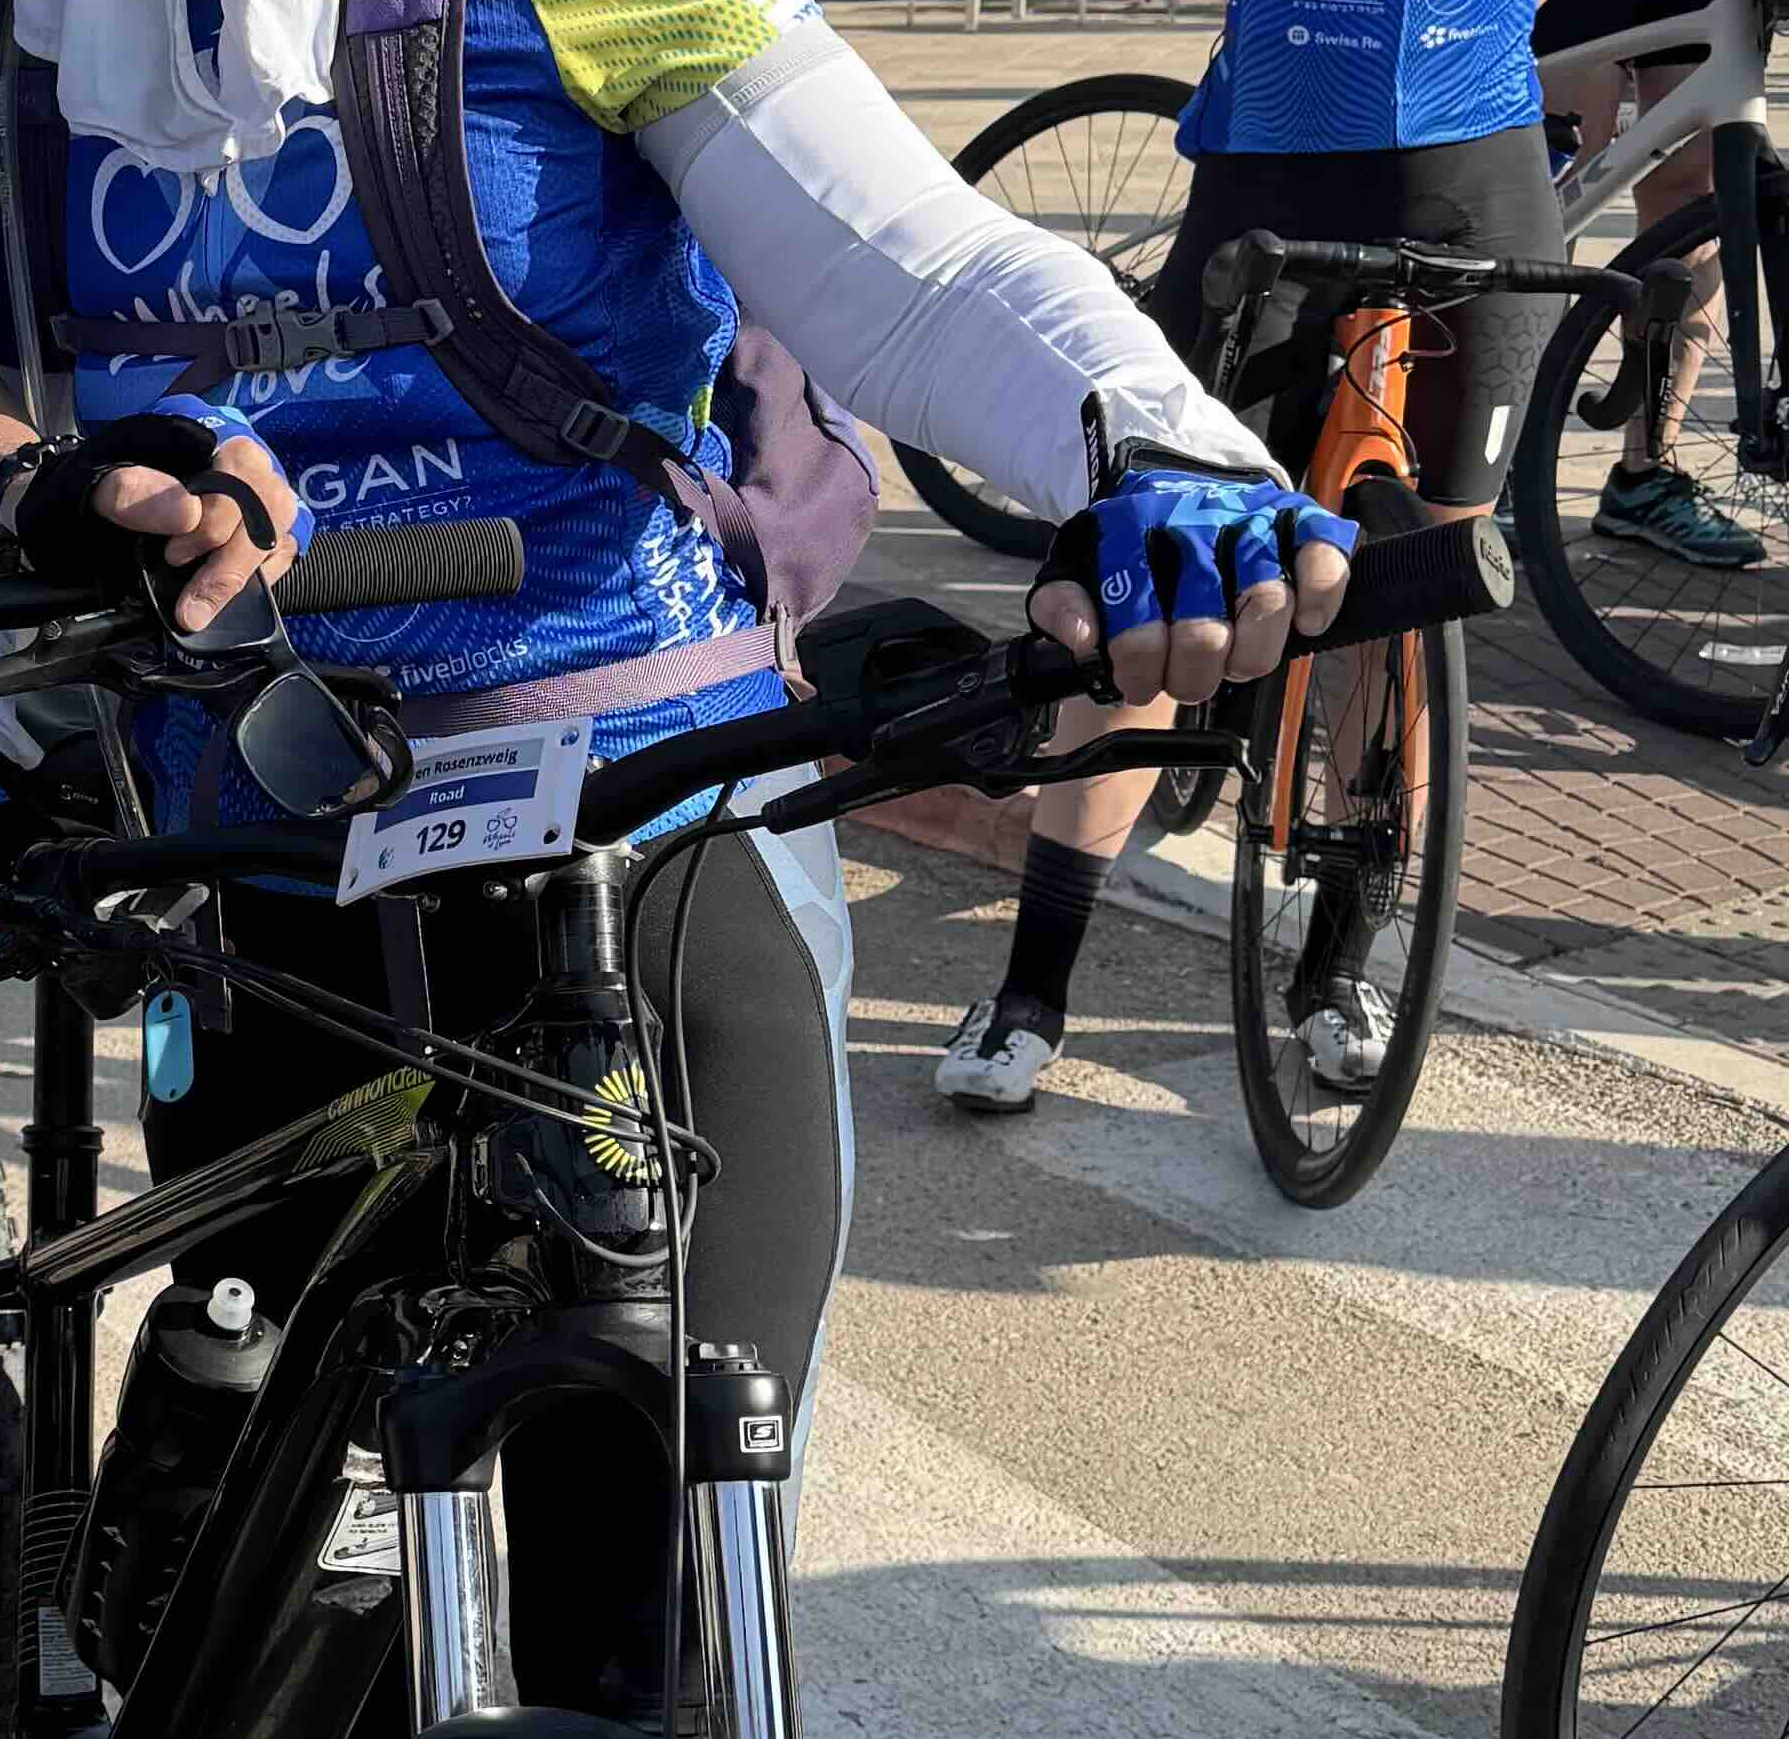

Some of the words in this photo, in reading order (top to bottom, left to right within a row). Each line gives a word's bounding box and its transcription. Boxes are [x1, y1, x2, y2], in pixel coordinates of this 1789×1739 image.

[399, 637, 529, 687] fiveblocks
[434, 749, 519, 775] Rosenzweig
[429, 785, 466, 805] Road
[416, 819, 467, 855] 129
